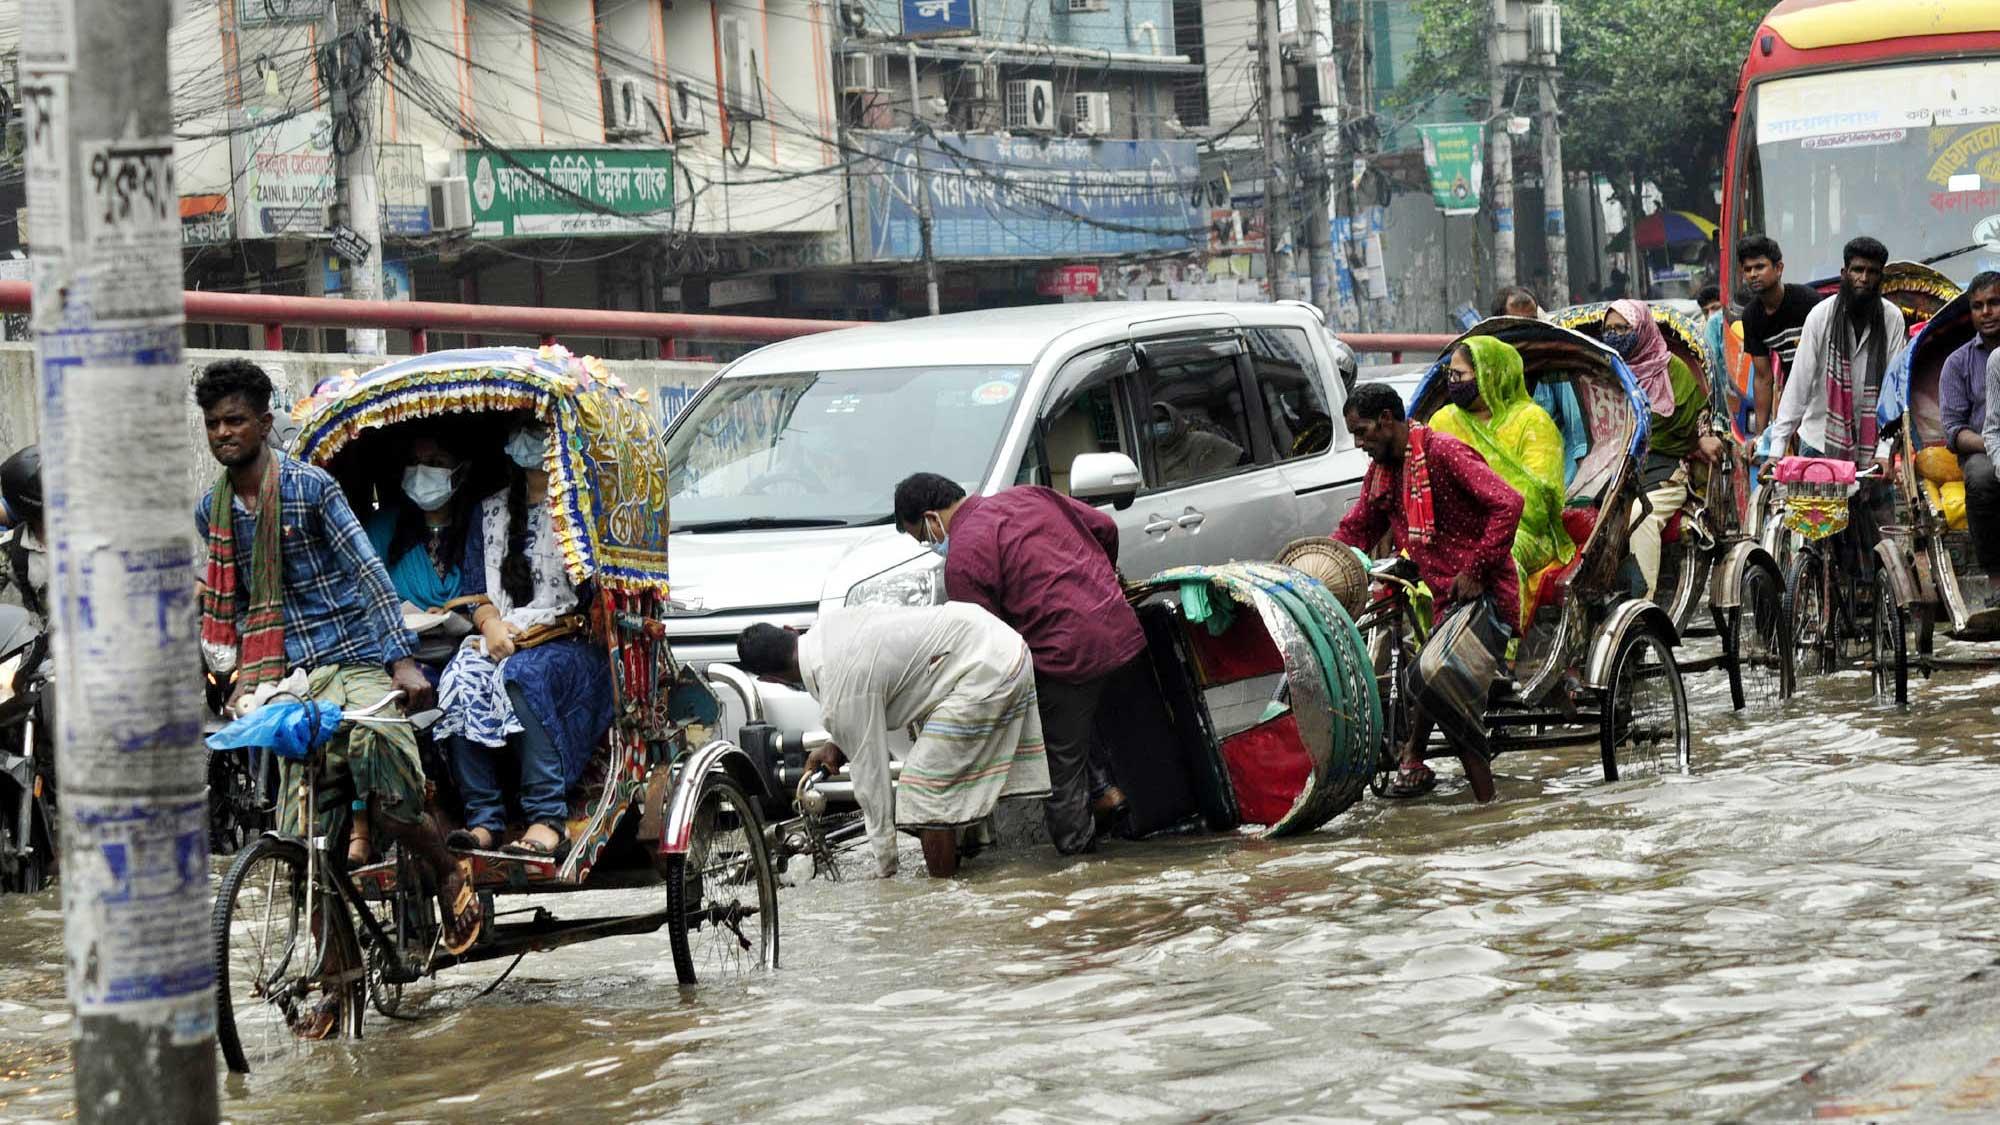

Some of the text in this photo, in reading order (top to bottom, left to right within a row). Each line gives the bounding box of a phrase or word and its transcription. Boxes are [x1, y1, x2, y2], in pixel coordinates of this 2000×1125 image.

[257, 185, 290, 202] ZAINUL
[595, 157, 631, 204] উন্নয়ন
[633, 163, 668, 203] ব্যাংক
